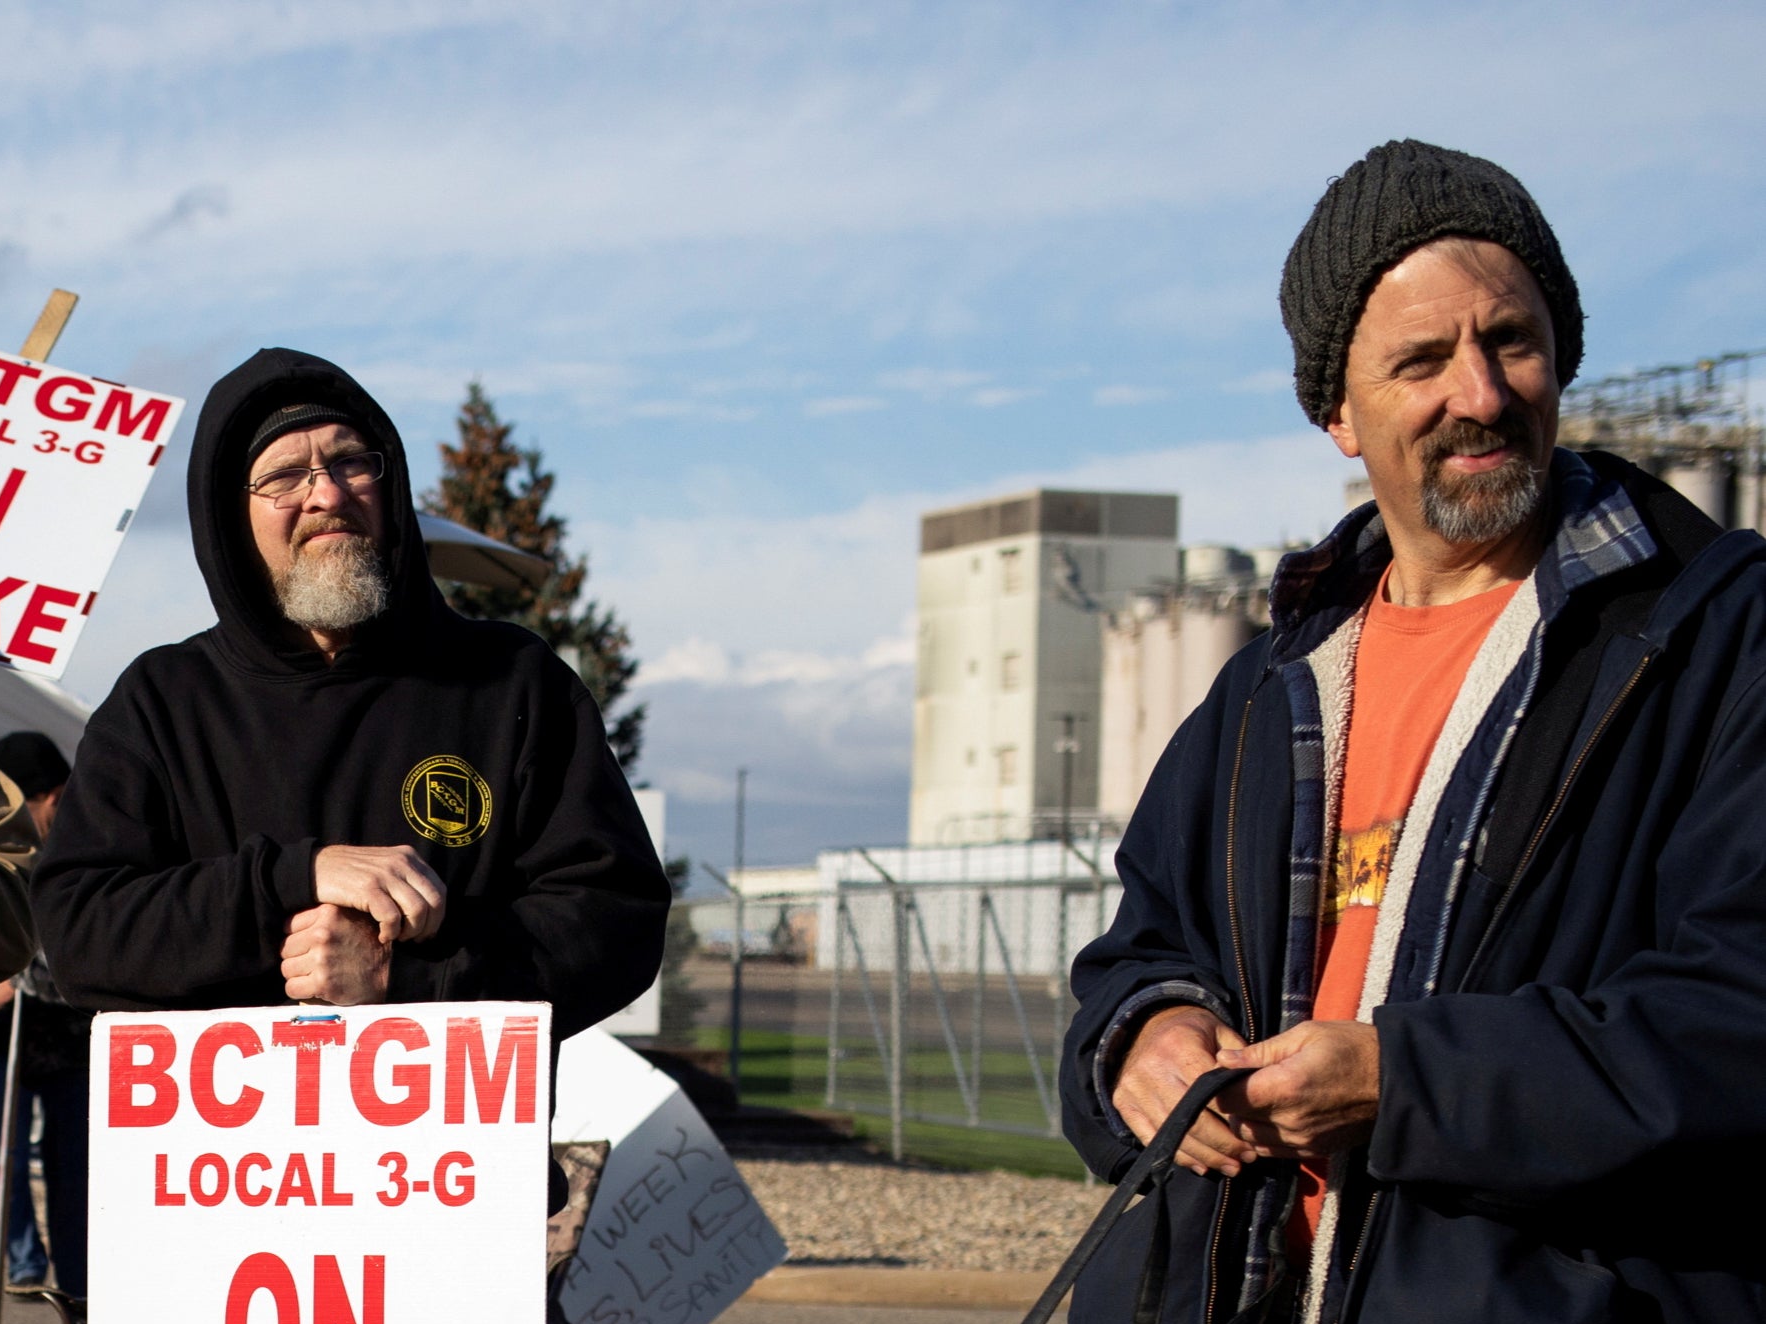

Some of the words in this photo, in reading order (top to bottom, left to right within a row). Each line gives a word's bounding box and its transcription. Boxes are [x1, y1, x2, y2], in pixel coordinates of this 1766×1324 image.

[33, 429, 106, 465] 3-G
[430, 781, 465, 815] BCTGM
[107, 1016, 540, 1129] BCTGM
[154, 1151, 354, 1207] LOCAL
[375, 1151, 477, 1207] 3-G
[592, 1125, 713, 1250] WEEK
